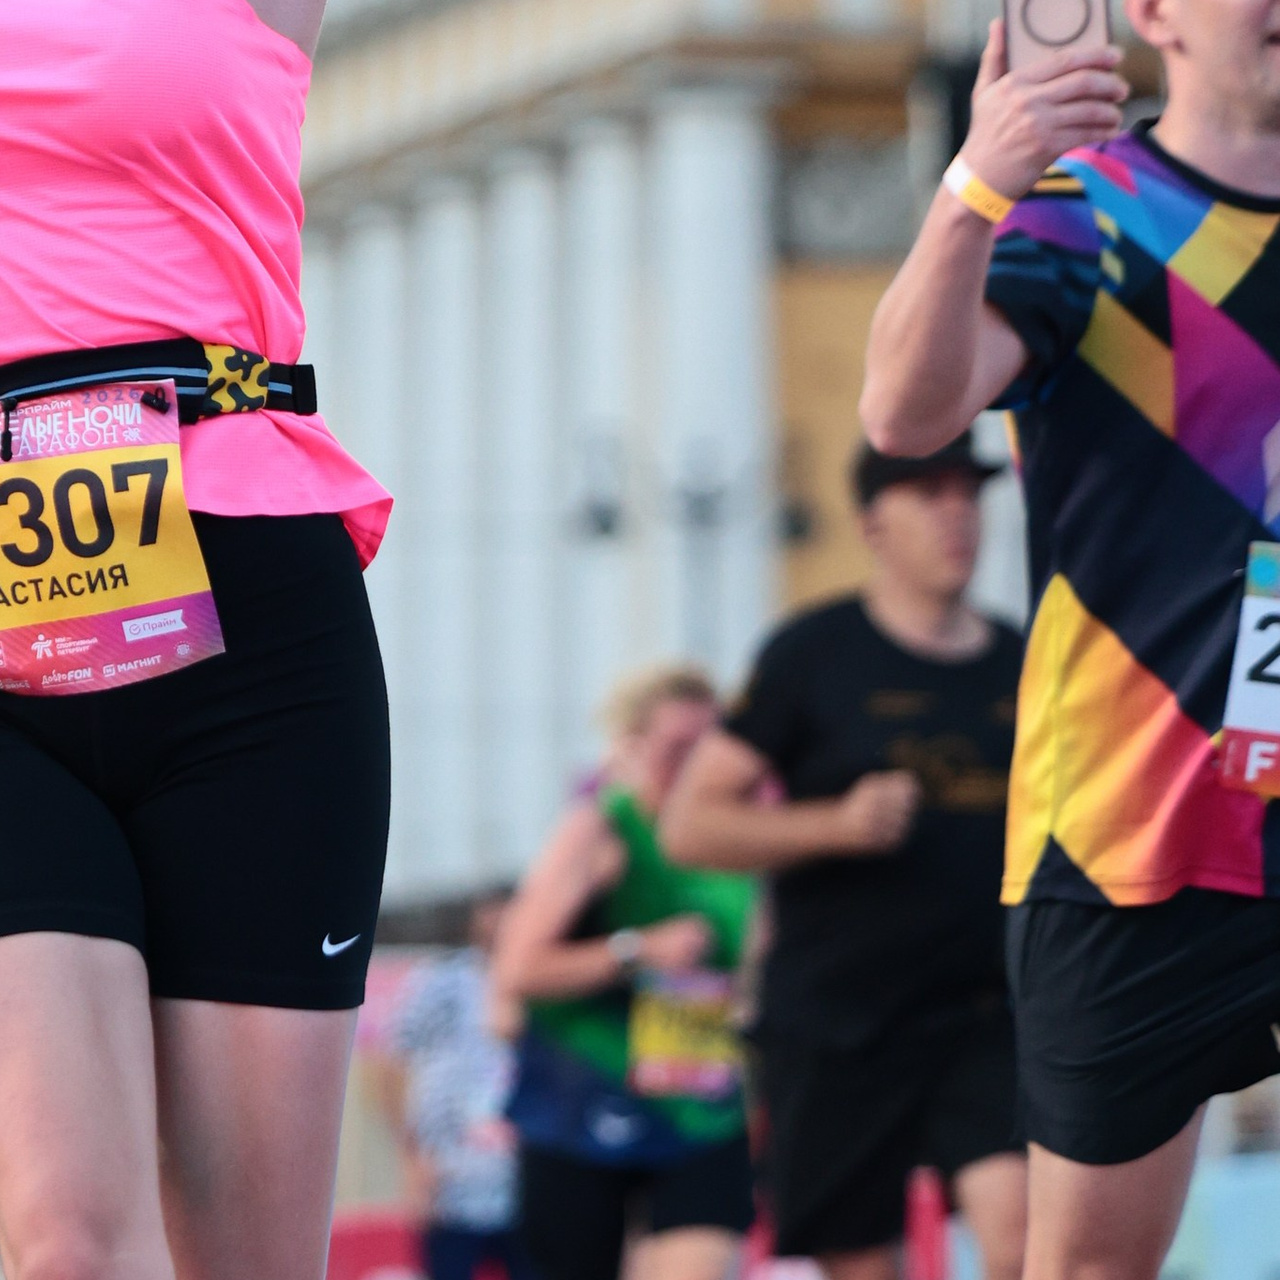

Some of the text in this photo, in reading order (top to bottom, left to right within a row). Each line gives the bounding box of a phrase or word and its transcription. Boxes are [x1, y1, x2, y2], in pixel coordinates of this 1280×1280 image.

[81, 387, 141, 405] 2026
[67, 403, 142, 434] НОЧИ
[142, 618, 177, 632] Прайм
[117, 654, 162, 673] МАГНИТ
[1244, 740, 1279, 782] F
